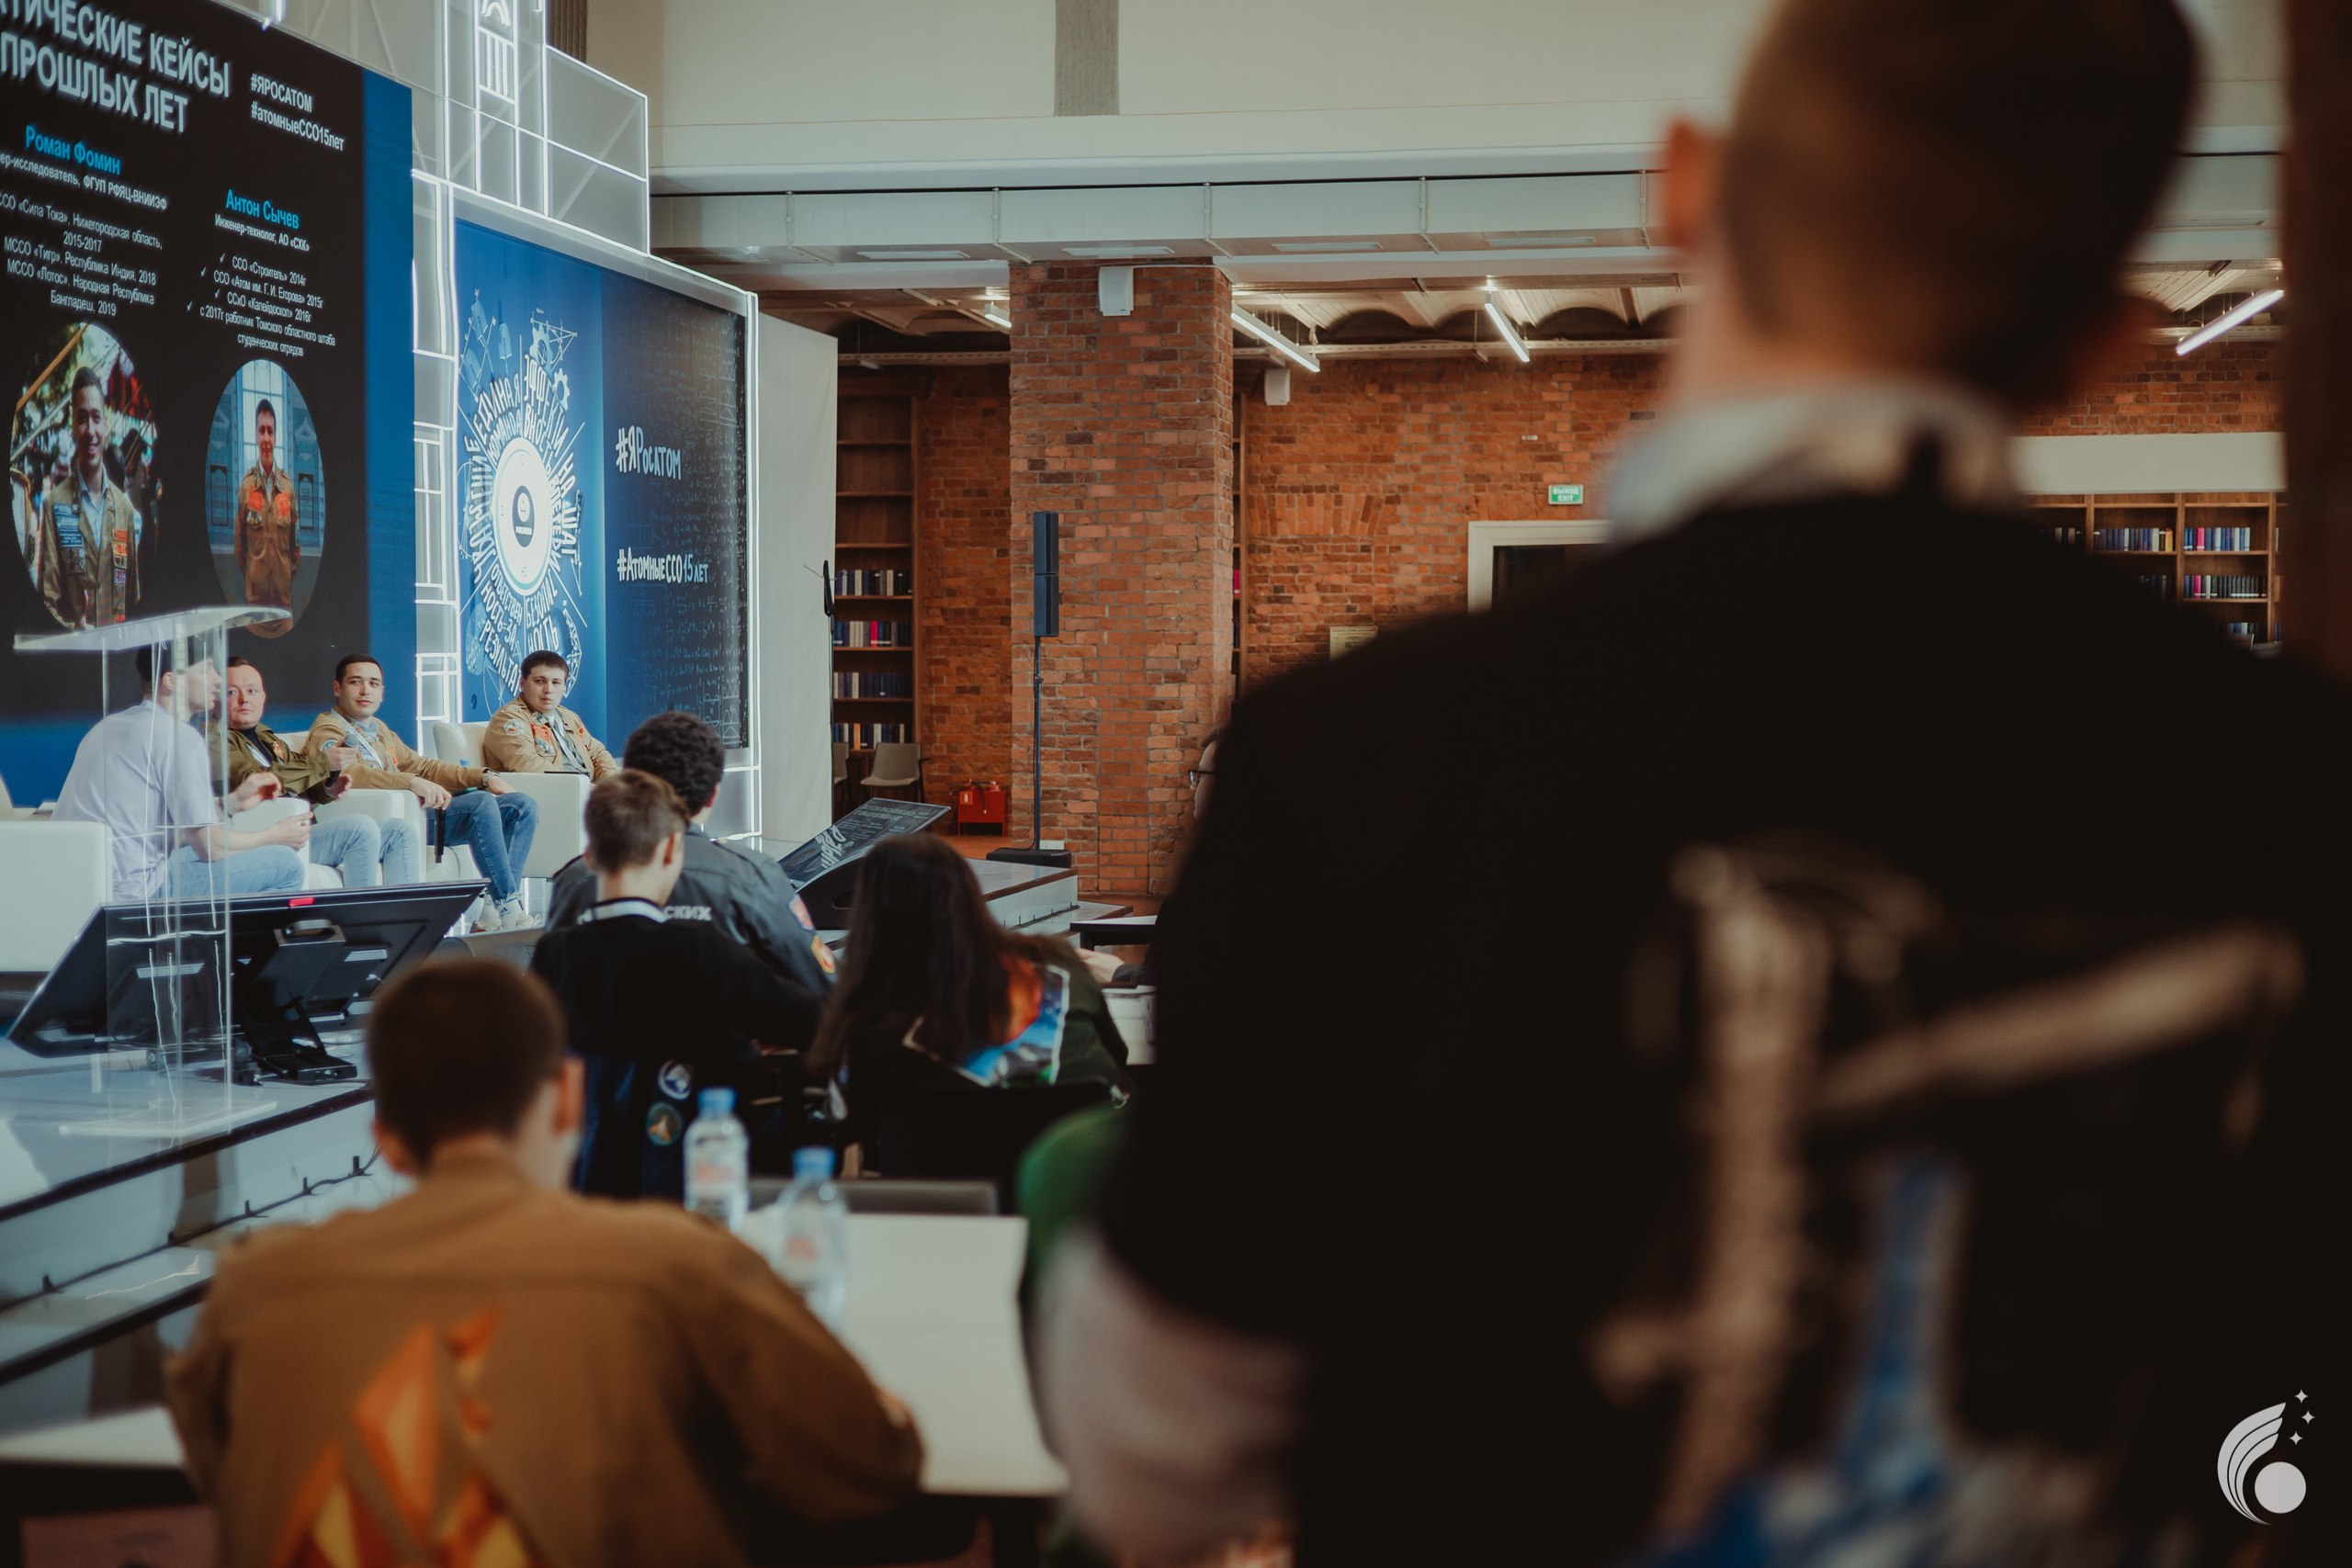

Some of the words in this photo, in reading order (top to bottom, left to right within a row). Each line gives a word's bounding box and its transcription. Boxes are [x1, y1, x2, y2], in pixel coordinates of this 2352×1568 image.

[1, 31, 138, 118] ПРОШЛЫХ
[143, 85, 187, 133] ЛЕТ
[150, 32, 230, 98] КЕЙСЫ
[251, 73, 312, 113] #ЯРОСАТОМ
[251, 101, 345, 152] #атомныеССО15лет
[26, 125, 71, 160] Роман
[74, 141, 120, 175] Фомин
[84, 175, 106, 193] ФГУП
[107, 182, 167, 210] РФЯЦ-ВНИИЭФ
[226, 188, 260, 217] Антон
[263, 200, 300, 229] Сычев
[63, 231, 102, 253] 2015-2017
[73, 212, 130, 240] Нижегородская
[132, 230, 163, 250] область,
[215, 213, 277, 244] Инженер-технолог,
[278, 233, 288, 246] АО
[4, 237, 31, 255] МССО
[65, 252, 109, 274] Республика
[111, 263, 137, 283] Индия,
[139, 269, 156, 286] 2018
[213, 270, 230, 285] ССО
[232, 256, 248, 271] ССО
[7, 258, 34, 277] МССО
[73, 275, 110, 295] Народная
[112, 283, 154, 305] Республика
[97, 300, 117, 316] 2019
[225, 310, 254, 328] работник
[255, 316, 283, 334] Томского
[284, 324, 316, 342] областного
[237, 333, 279, 352] студенческих
[279, 342, 304, 357] отрядов
[473, 373, 521, 446] ЕДИНАЯ
